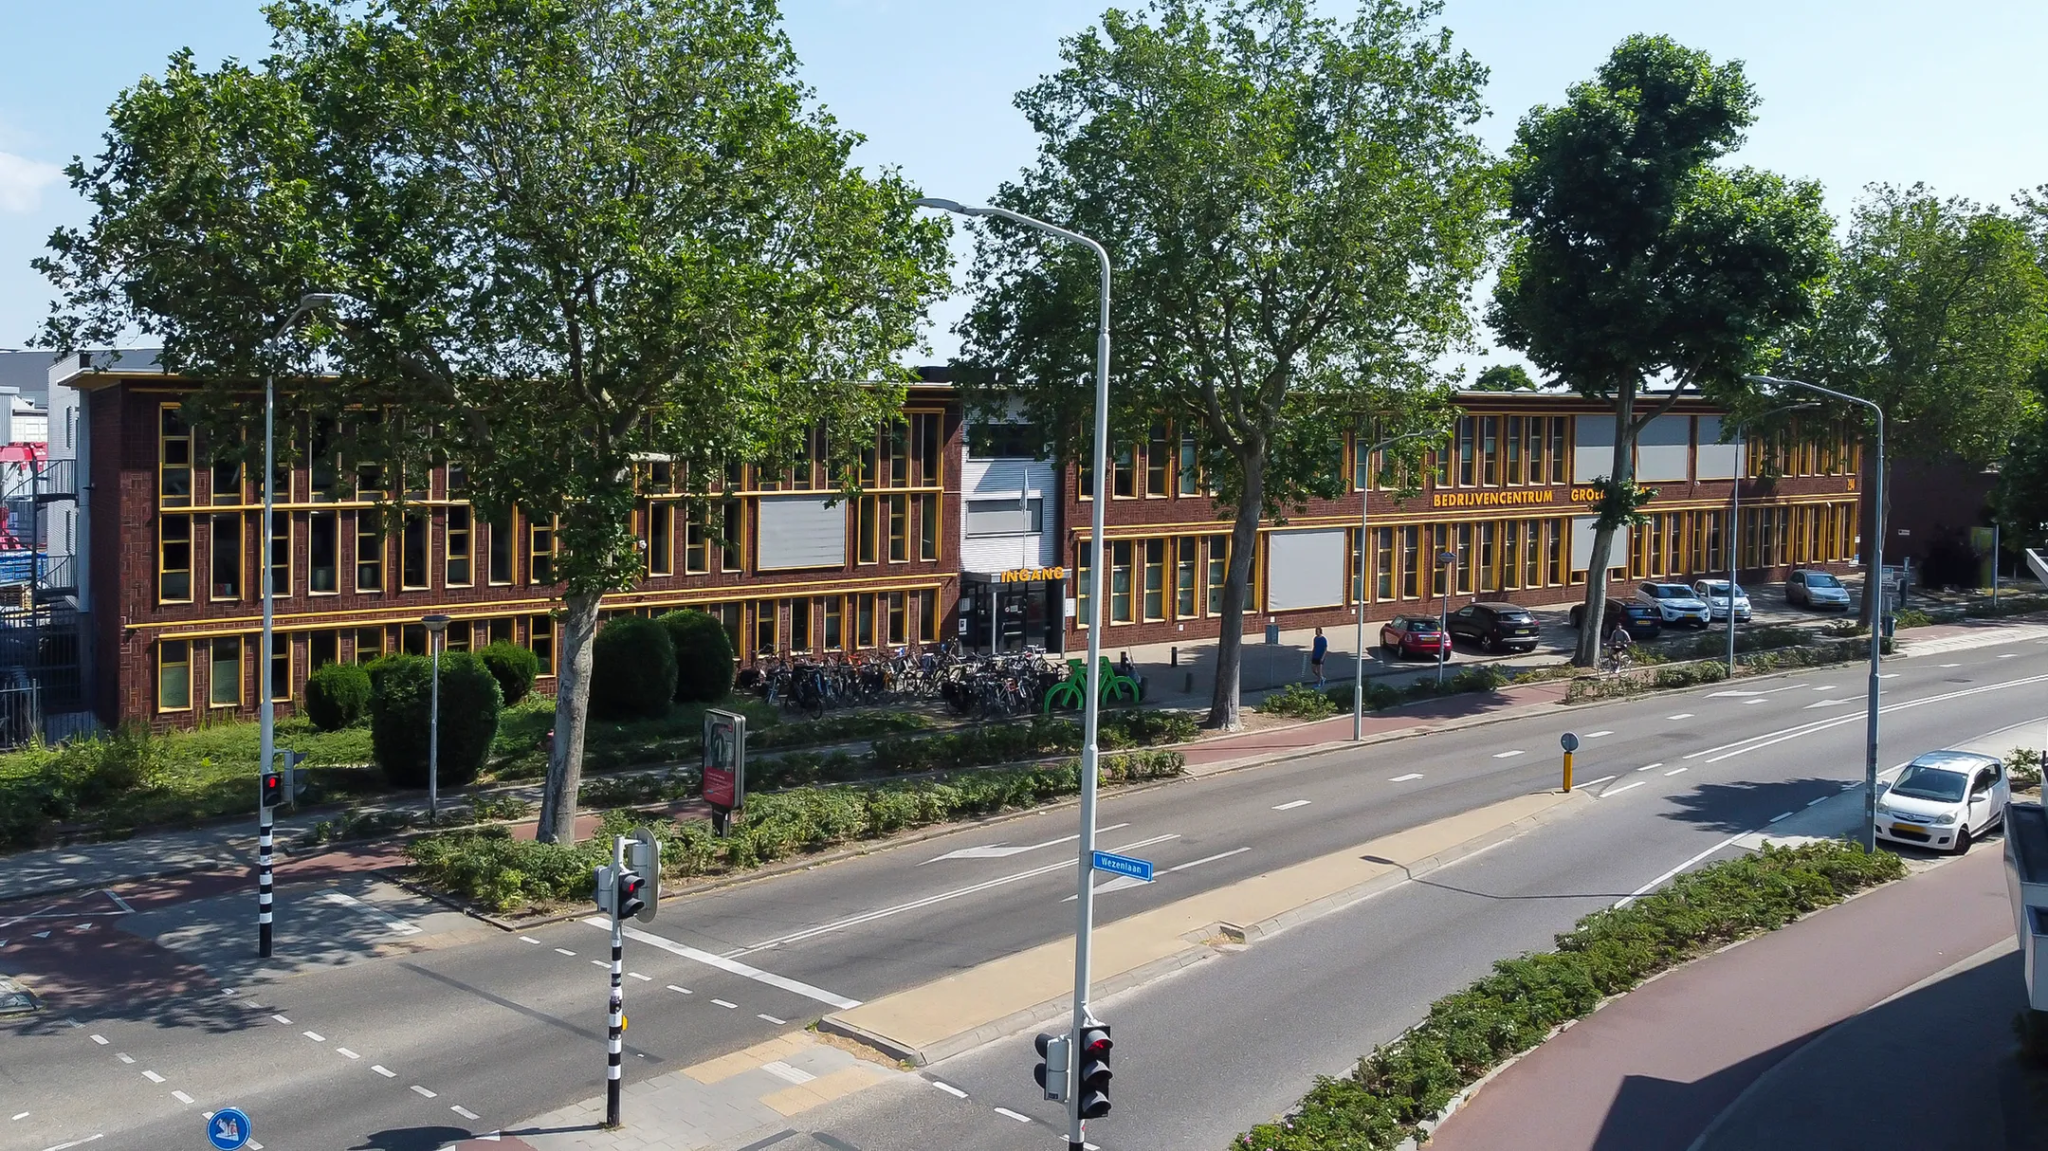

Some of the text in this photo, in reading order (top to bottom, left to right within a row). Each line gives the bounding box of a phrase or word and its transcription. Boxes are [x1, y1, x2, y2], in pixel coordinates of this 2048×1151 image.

[1433, 490, 1553, 507] BEDRIJVENCENTRUM
[1001, 566, 1065, 583] INGANG
[1101, 856, 1142, 874] Wezenlaan
